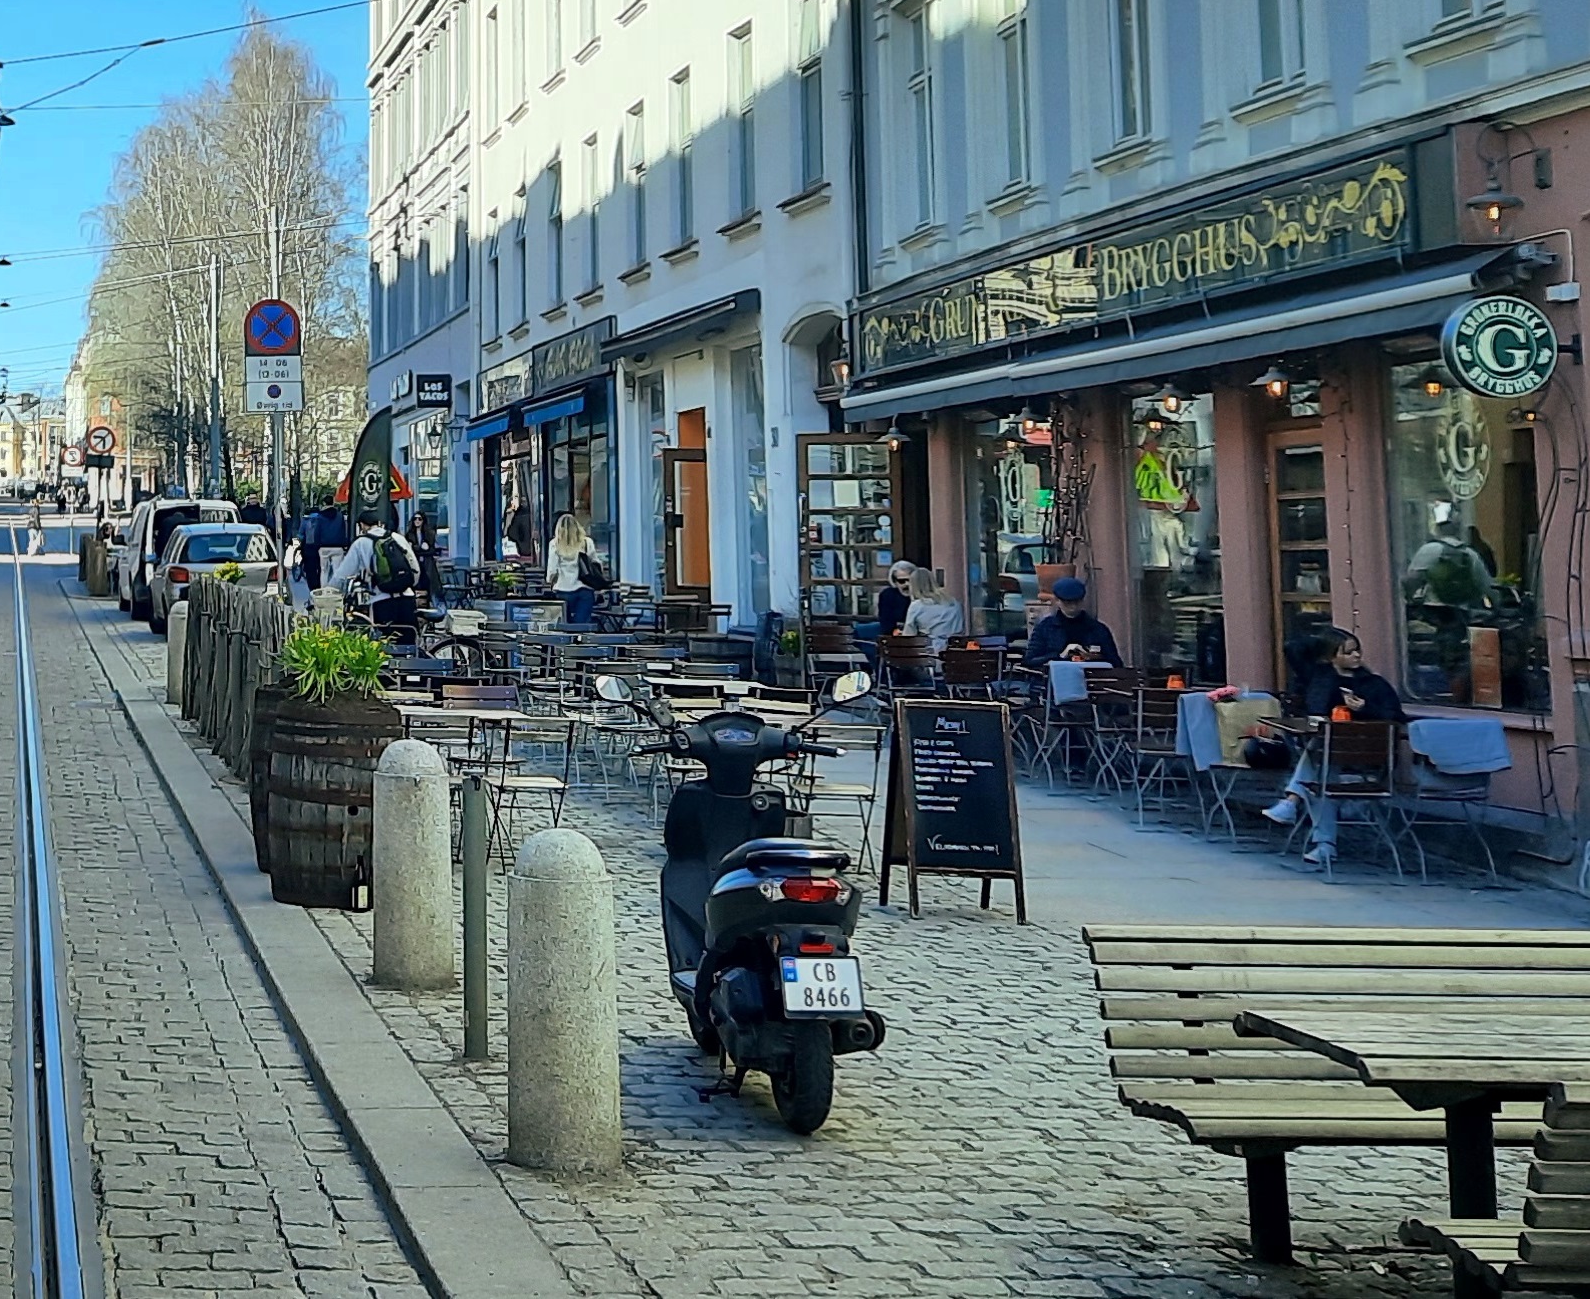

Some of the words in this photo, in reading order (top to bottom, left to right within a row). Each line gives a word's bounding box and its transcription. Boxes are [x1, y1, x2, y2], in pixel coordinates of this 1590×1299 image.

[1100, 213, 1258, 301] BRYGGHUS
[1477, 323, 1531, 373] G
[424, 382, 443, 391] LOS
[1468, 366, 1542, 394] BRYGGHUS
[419, 391, 449, 401] TACOS
[364, 472, 378, 493] G
[813, 962, 836, 982] CB
[804, 986, 850, 1007] 8466
